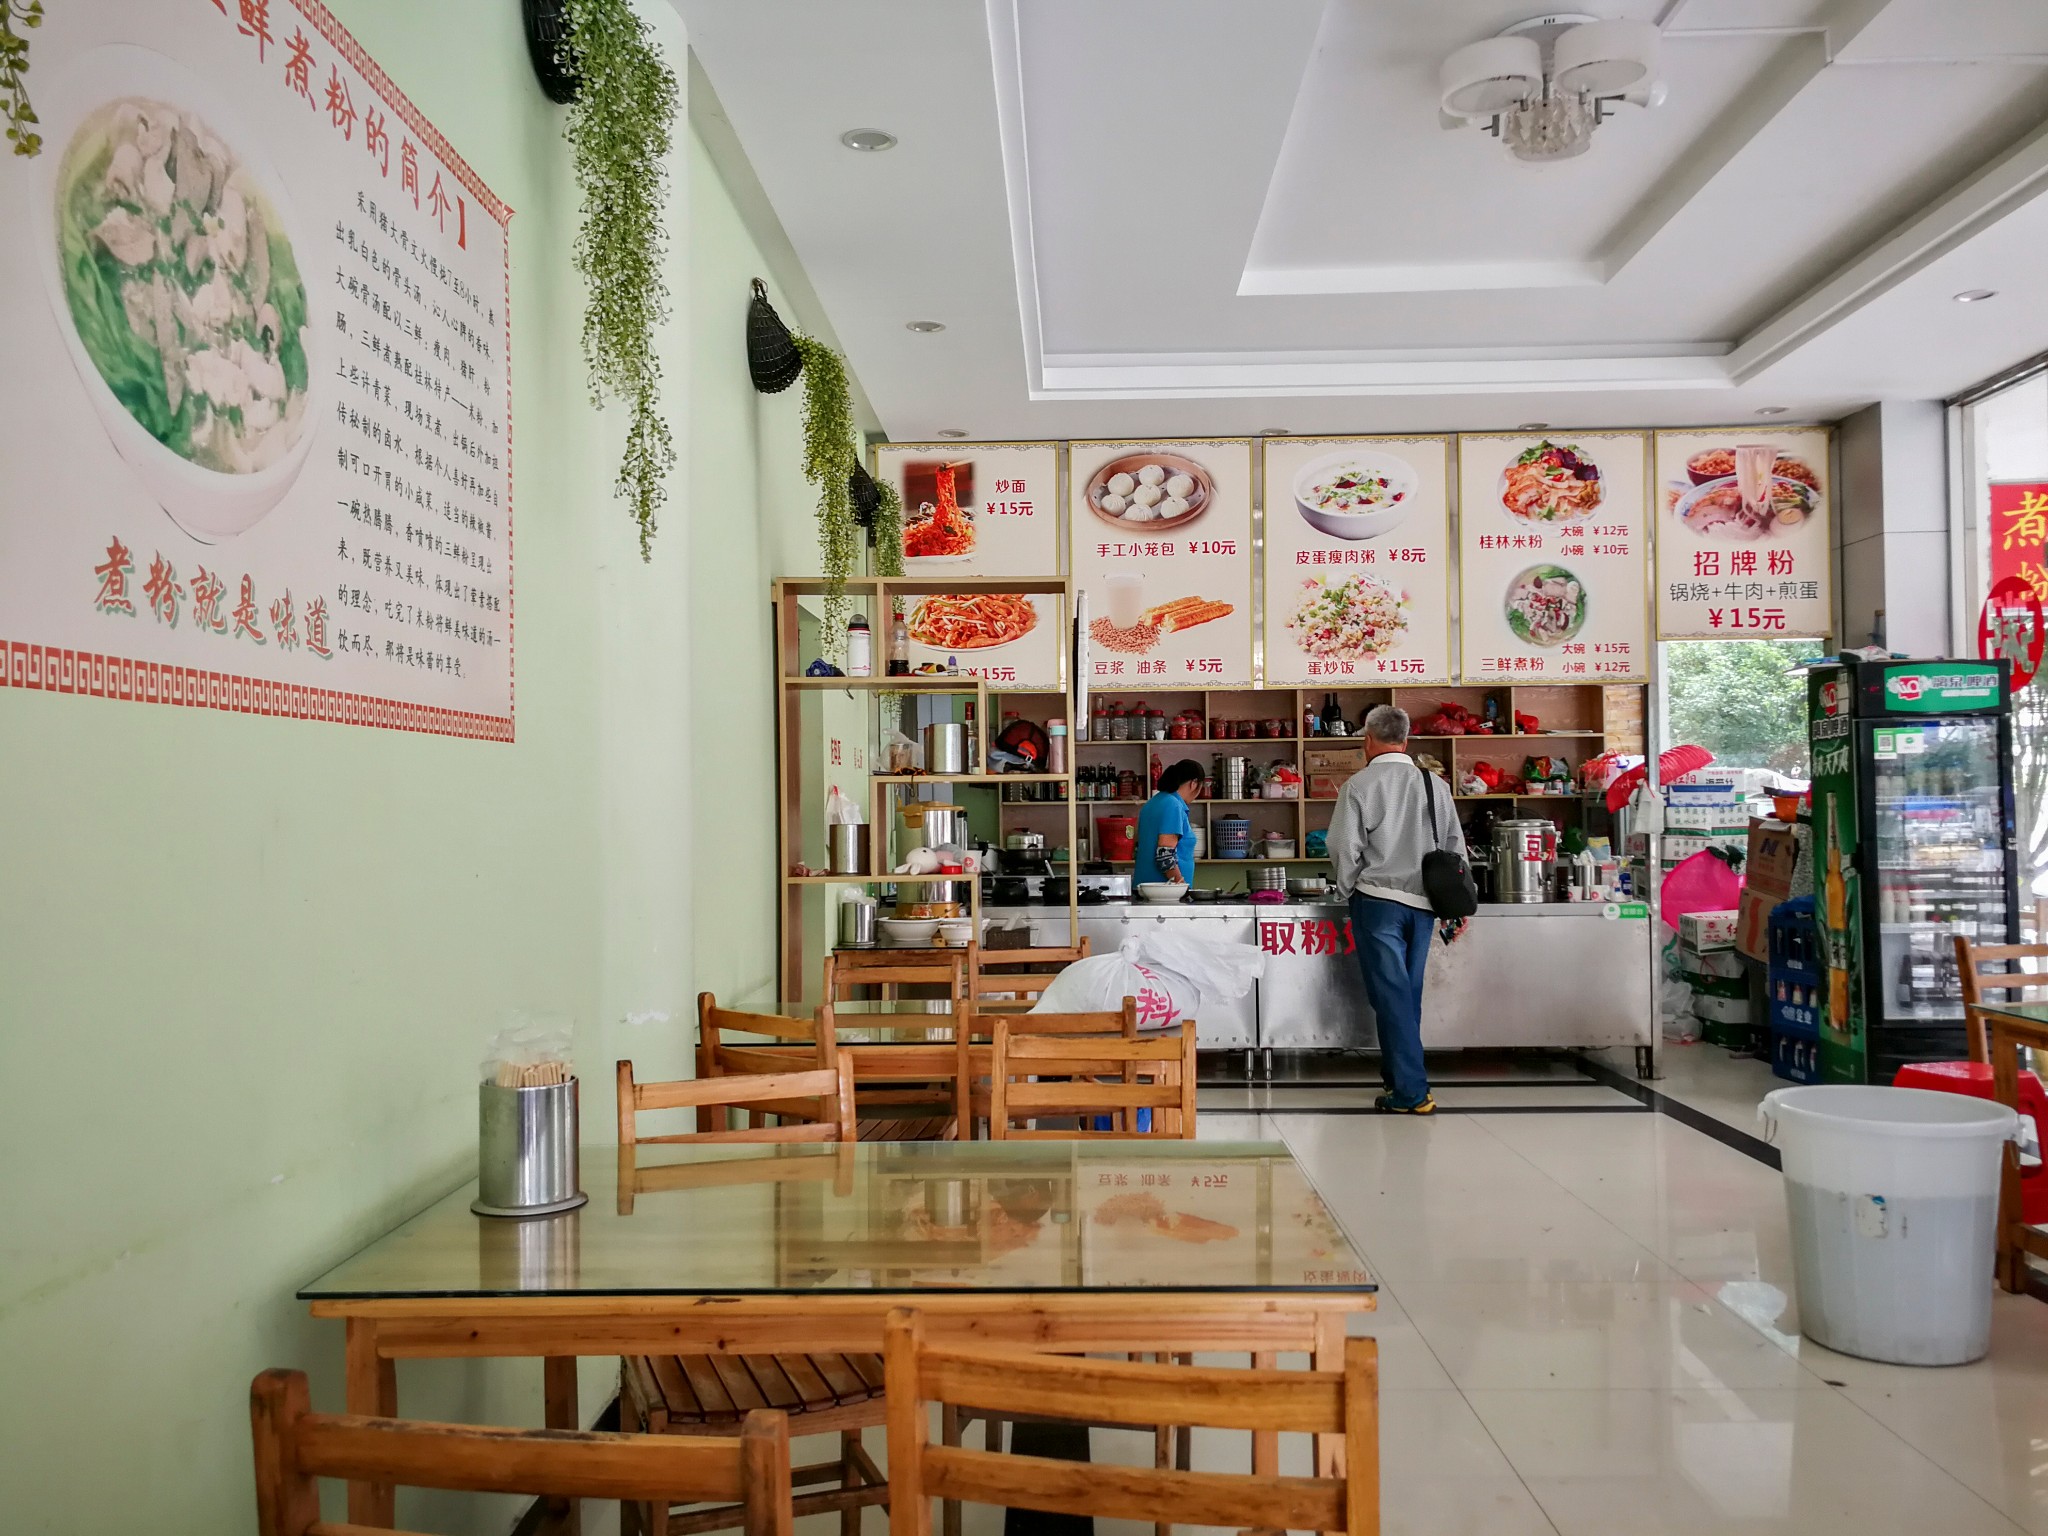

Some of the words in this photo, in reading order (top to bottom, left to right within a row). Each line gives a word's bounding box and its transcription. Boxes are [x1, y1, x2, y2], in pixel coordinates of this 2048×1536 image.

[212, 0, 466, 251] 鲜煮粉的简介】
[995, 479, 1026, 494] 炒面
[986, 501, 1033, 516] ¥15元
[1560, 525, 1584, 537] 大碗
[1593, 525, 1629, 537] ¥12元
[1096, 542, 1175, 557] 手工小笼包
[1189, 541, 1236, 555] ¥10元
[1480, 534, 1543, 549] 桂林米粉
[1296, 550, 1375, 565] 皮蛋瘦肉粥
[1388, 548, 1426, 563] ¥8元
[1560, 544, 1584, 556] 小碗
[1593, 544, 1629, 555] ¥10元
[1693, 549, 1795, 577] 招牌粉
[94, 535, 333, 660] 煮粉就是味道
[1669, 581, 1818, 602] 锅烧+牛肉+煎蛋
[1708, 607, 1786, 630] ¥15元
[1562, 643, 1585, 655] 大碗
[1594, 642, 1630, 654] ¥15元
[1094, 660, 1124, 675] 豆浆
[1137, 659, 1167, 674] 油条
[1185, 658, 1223, 673] ¥5元
[1307, 660, 1354, 675] 蛋炒饭
[1376, 659, 1425, 673] ¥15元
[1481, 657, 1544, 672] 三鲜煮粉
[1562, 662, 1585, 674] 小碗
[1595, 661, 1630, 673] ¥12元
[1259, 920, 1357, 956] 取粉
